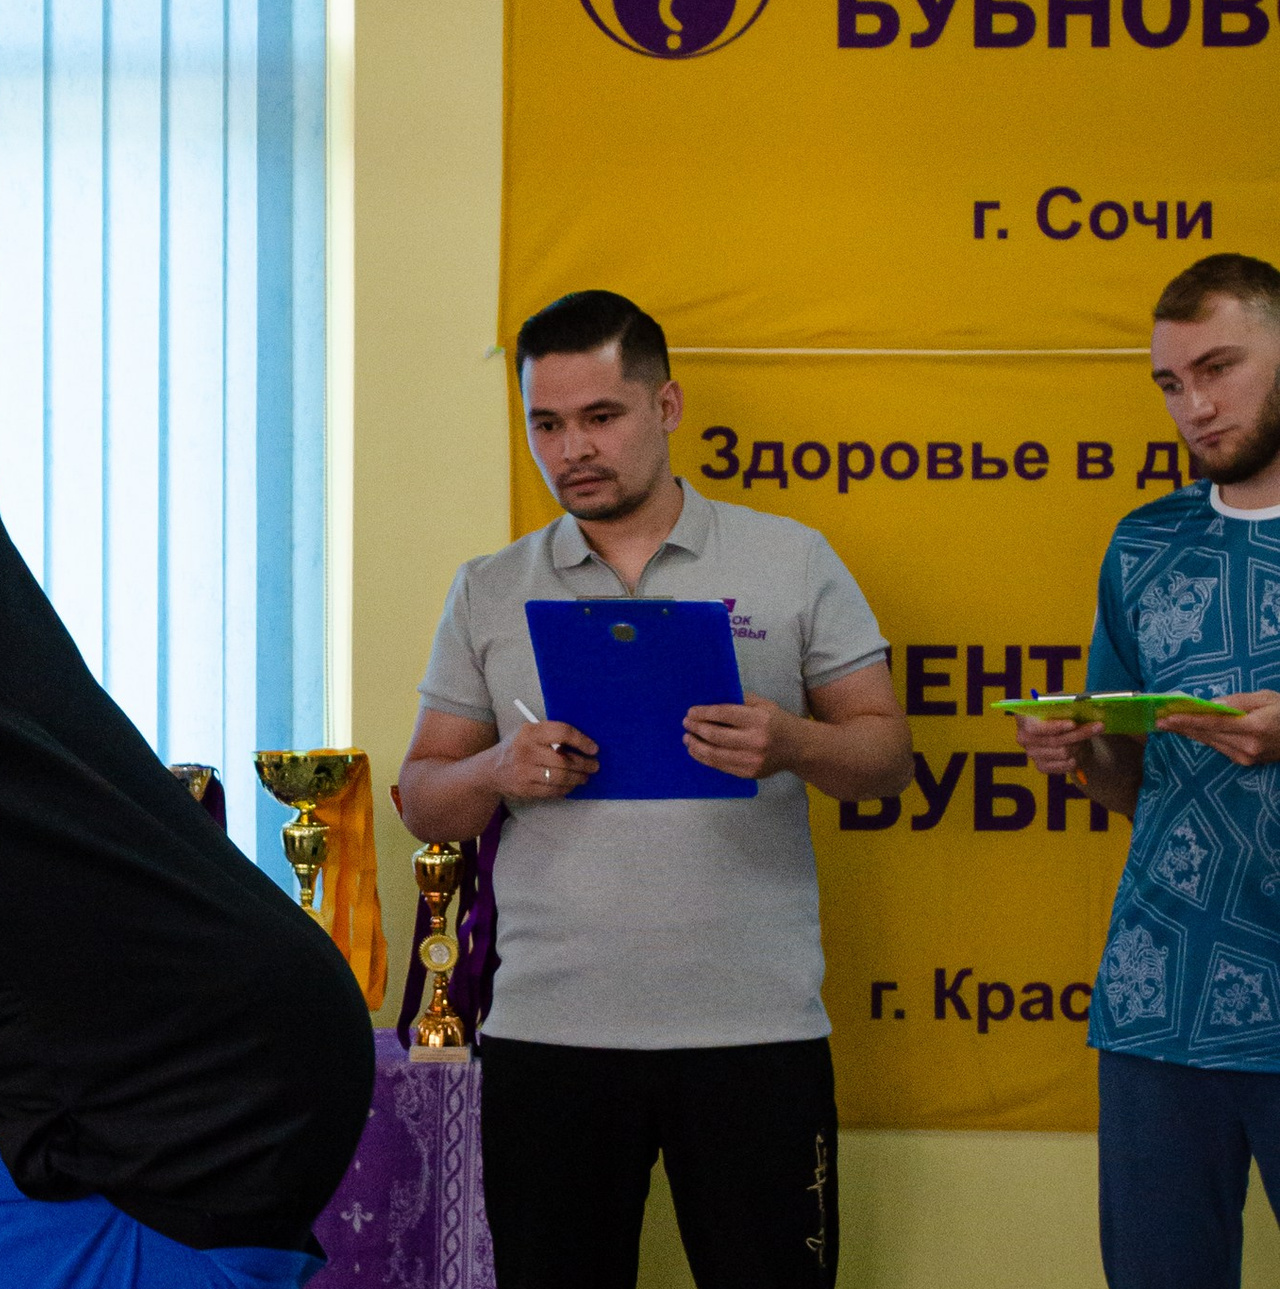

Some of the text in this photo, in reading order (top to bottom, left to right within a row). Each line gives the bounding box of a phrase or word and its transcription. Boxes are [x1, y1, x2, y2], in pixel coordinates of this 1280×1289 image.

[973, 186, 1213, 241] г. Сочи
[699, 425, 1050, 494] Здоровье
[1076, 441, 1115, 480] в
[731, 615, 752, 626] ОК
[884, 644, 1094, 717] ЕНТ
[870, 967, 1093, 1034] г. Крас
